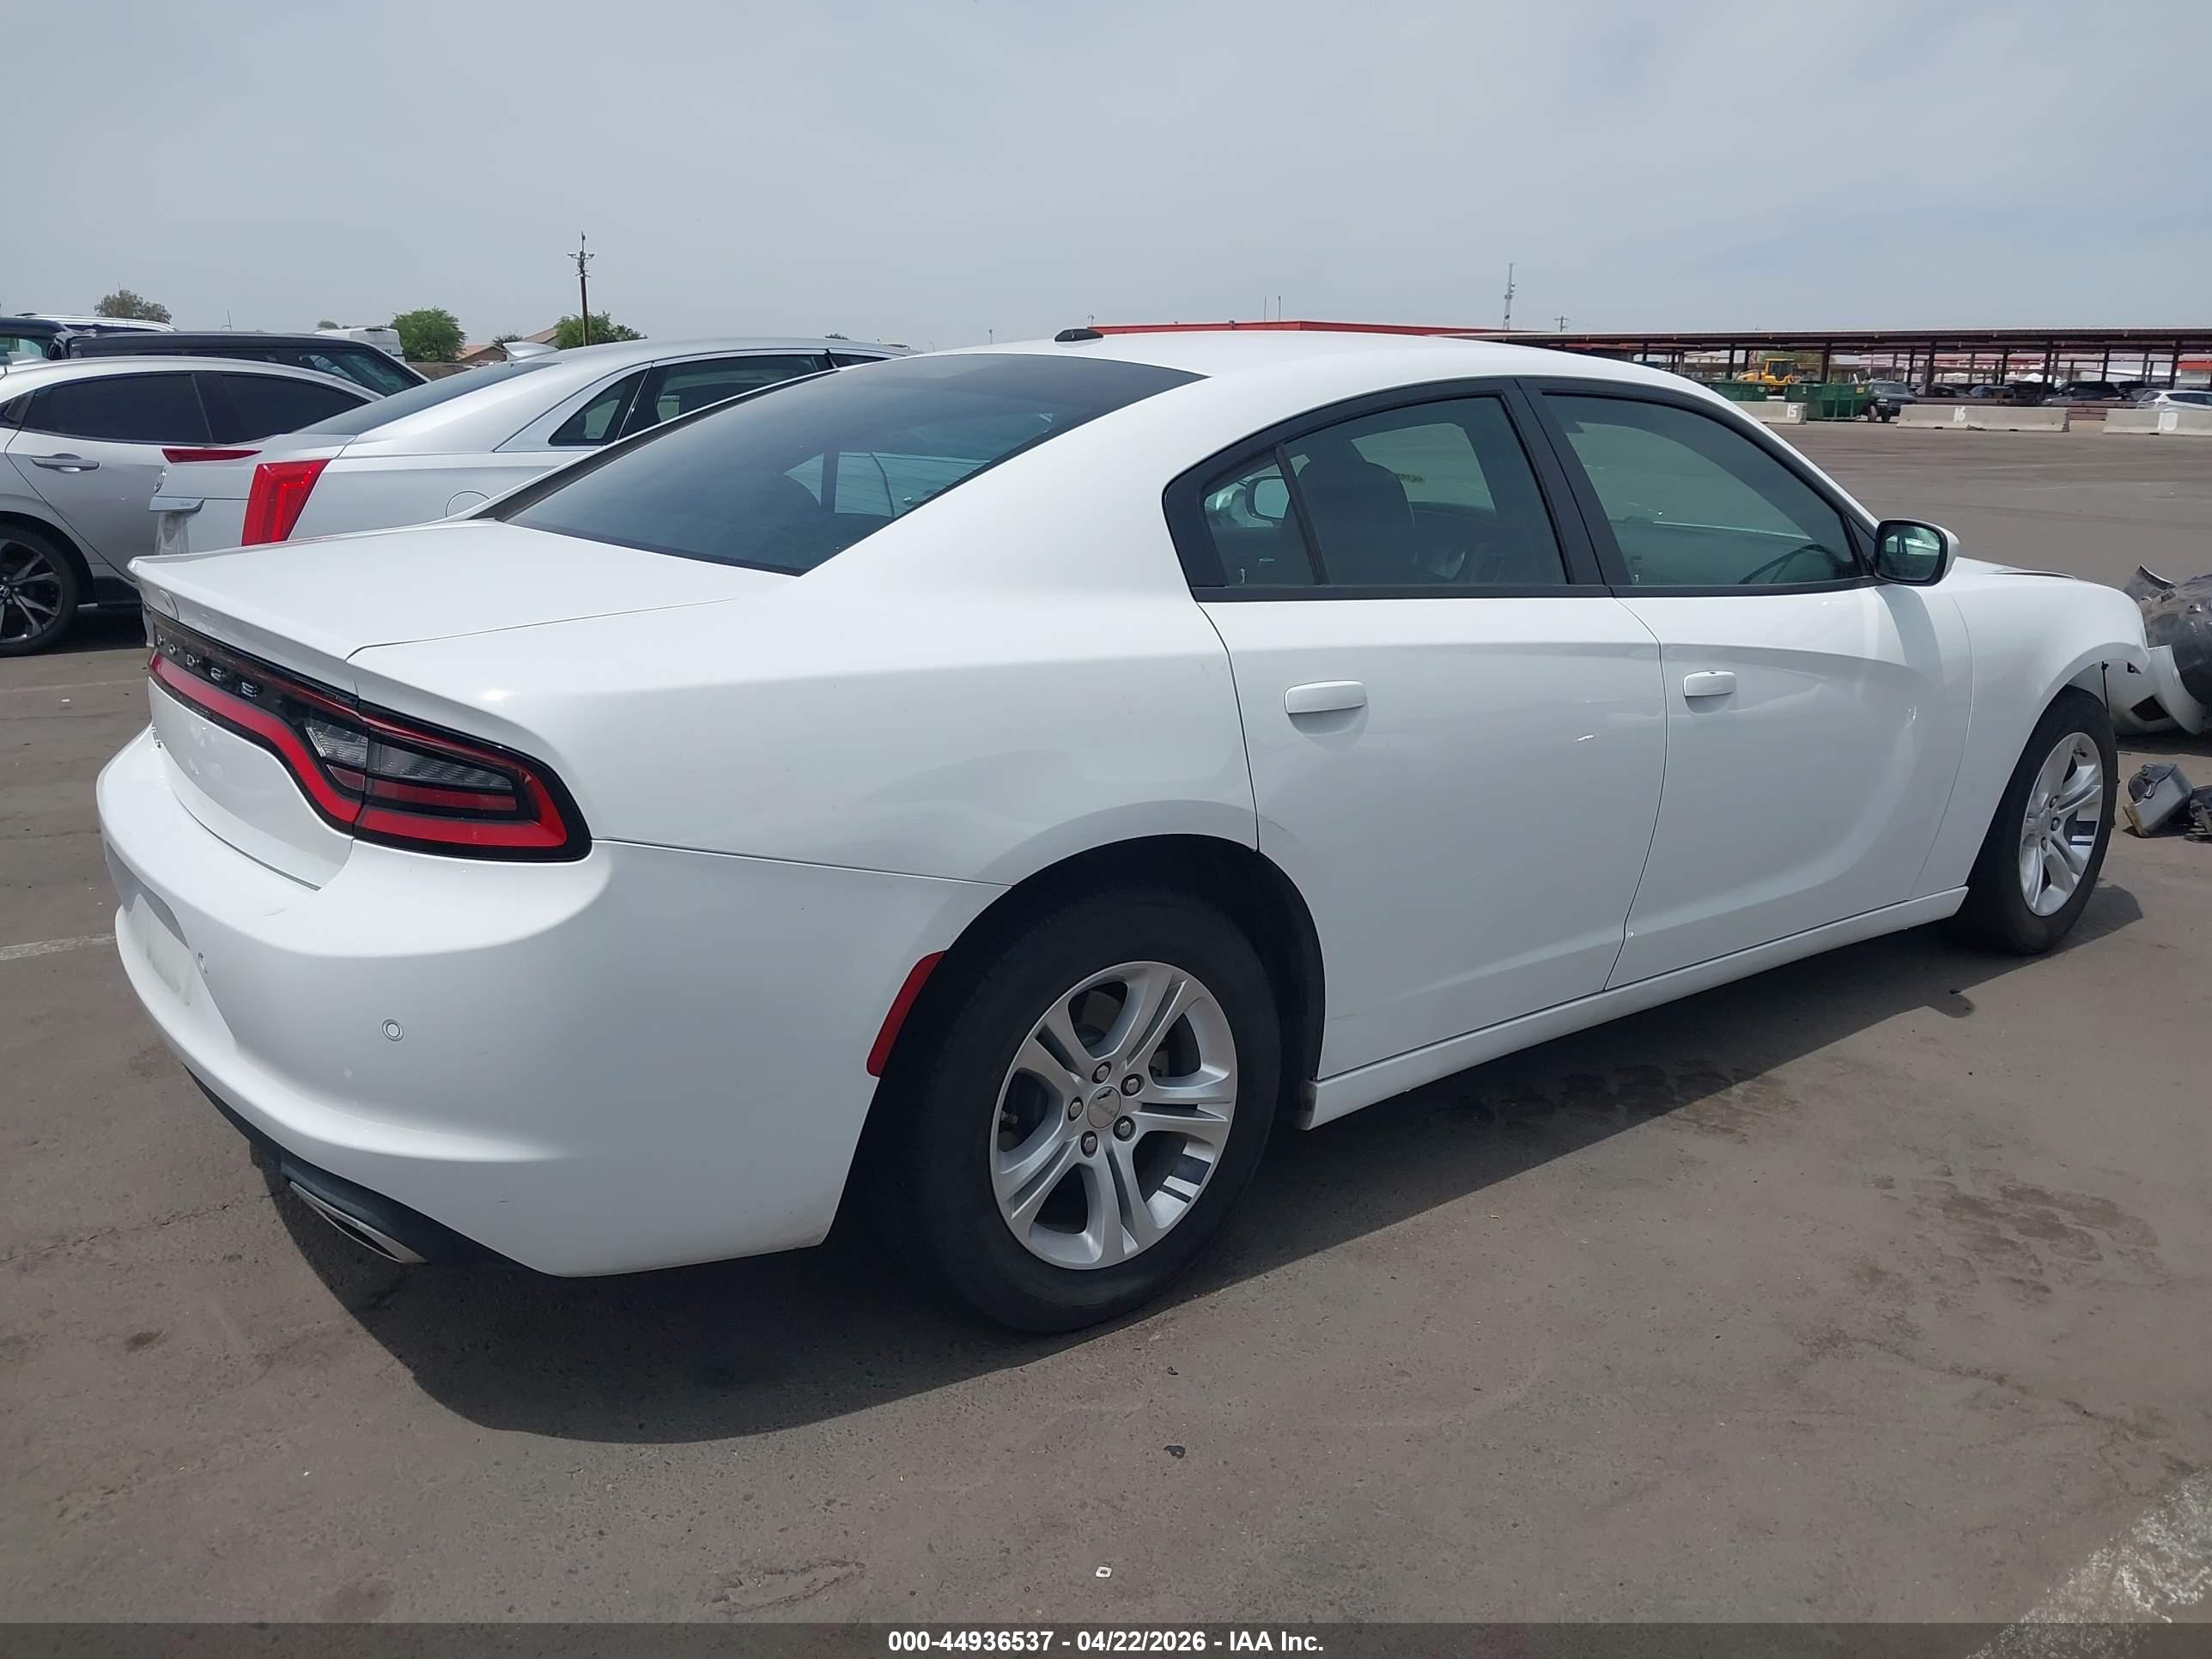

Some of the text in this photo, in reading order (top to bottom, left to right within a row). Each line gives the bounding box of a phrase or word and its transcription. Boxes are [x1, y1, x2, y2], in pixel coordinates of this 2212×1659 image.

[1786, 404, 1799, 418] 15
[1954, 405, 1966, 422] 16
[156, 634, 257, 697] DODGE
